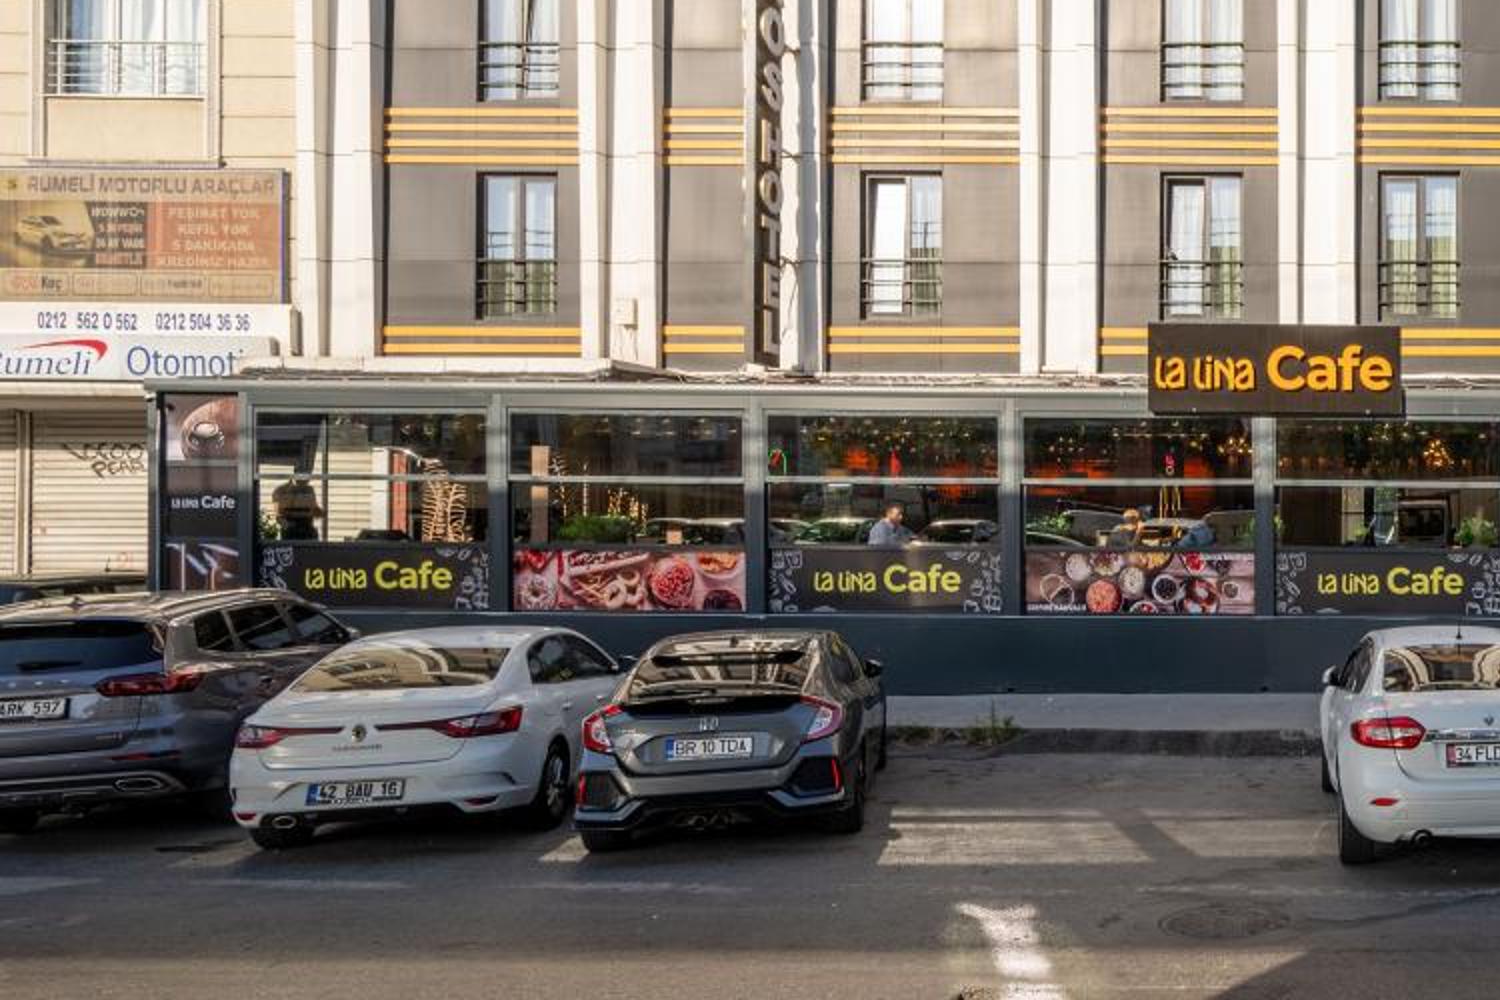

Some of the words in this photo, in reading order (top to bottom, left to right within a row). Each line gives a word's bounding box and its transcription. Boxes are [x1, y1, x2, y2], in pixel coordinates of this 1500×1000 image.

[37, 311, 67, 329] 0212
[77, 312, 98, 330] 562
[116, 313, 137, 331] 562
[155, 312, 186, 330] 0212
[189, 313, 212, 331] 504
[217, 314, 232, 331] 36
[235, 314, 250, 331] 36
[1267, 344, 1393, 391] Cafe
[201, 495, 236, 509] Cafe
[374, 560, 453, 590] Cafe
[883, 563, 962, 593] Cafe
[1387, 566, 1465, 595] Cafe
[34, 700, 61, 715] 597
[702, 740, 715, 754] 10
[1455, 746, 1472, 761] 34
[320, 784, 337, 799] 42
